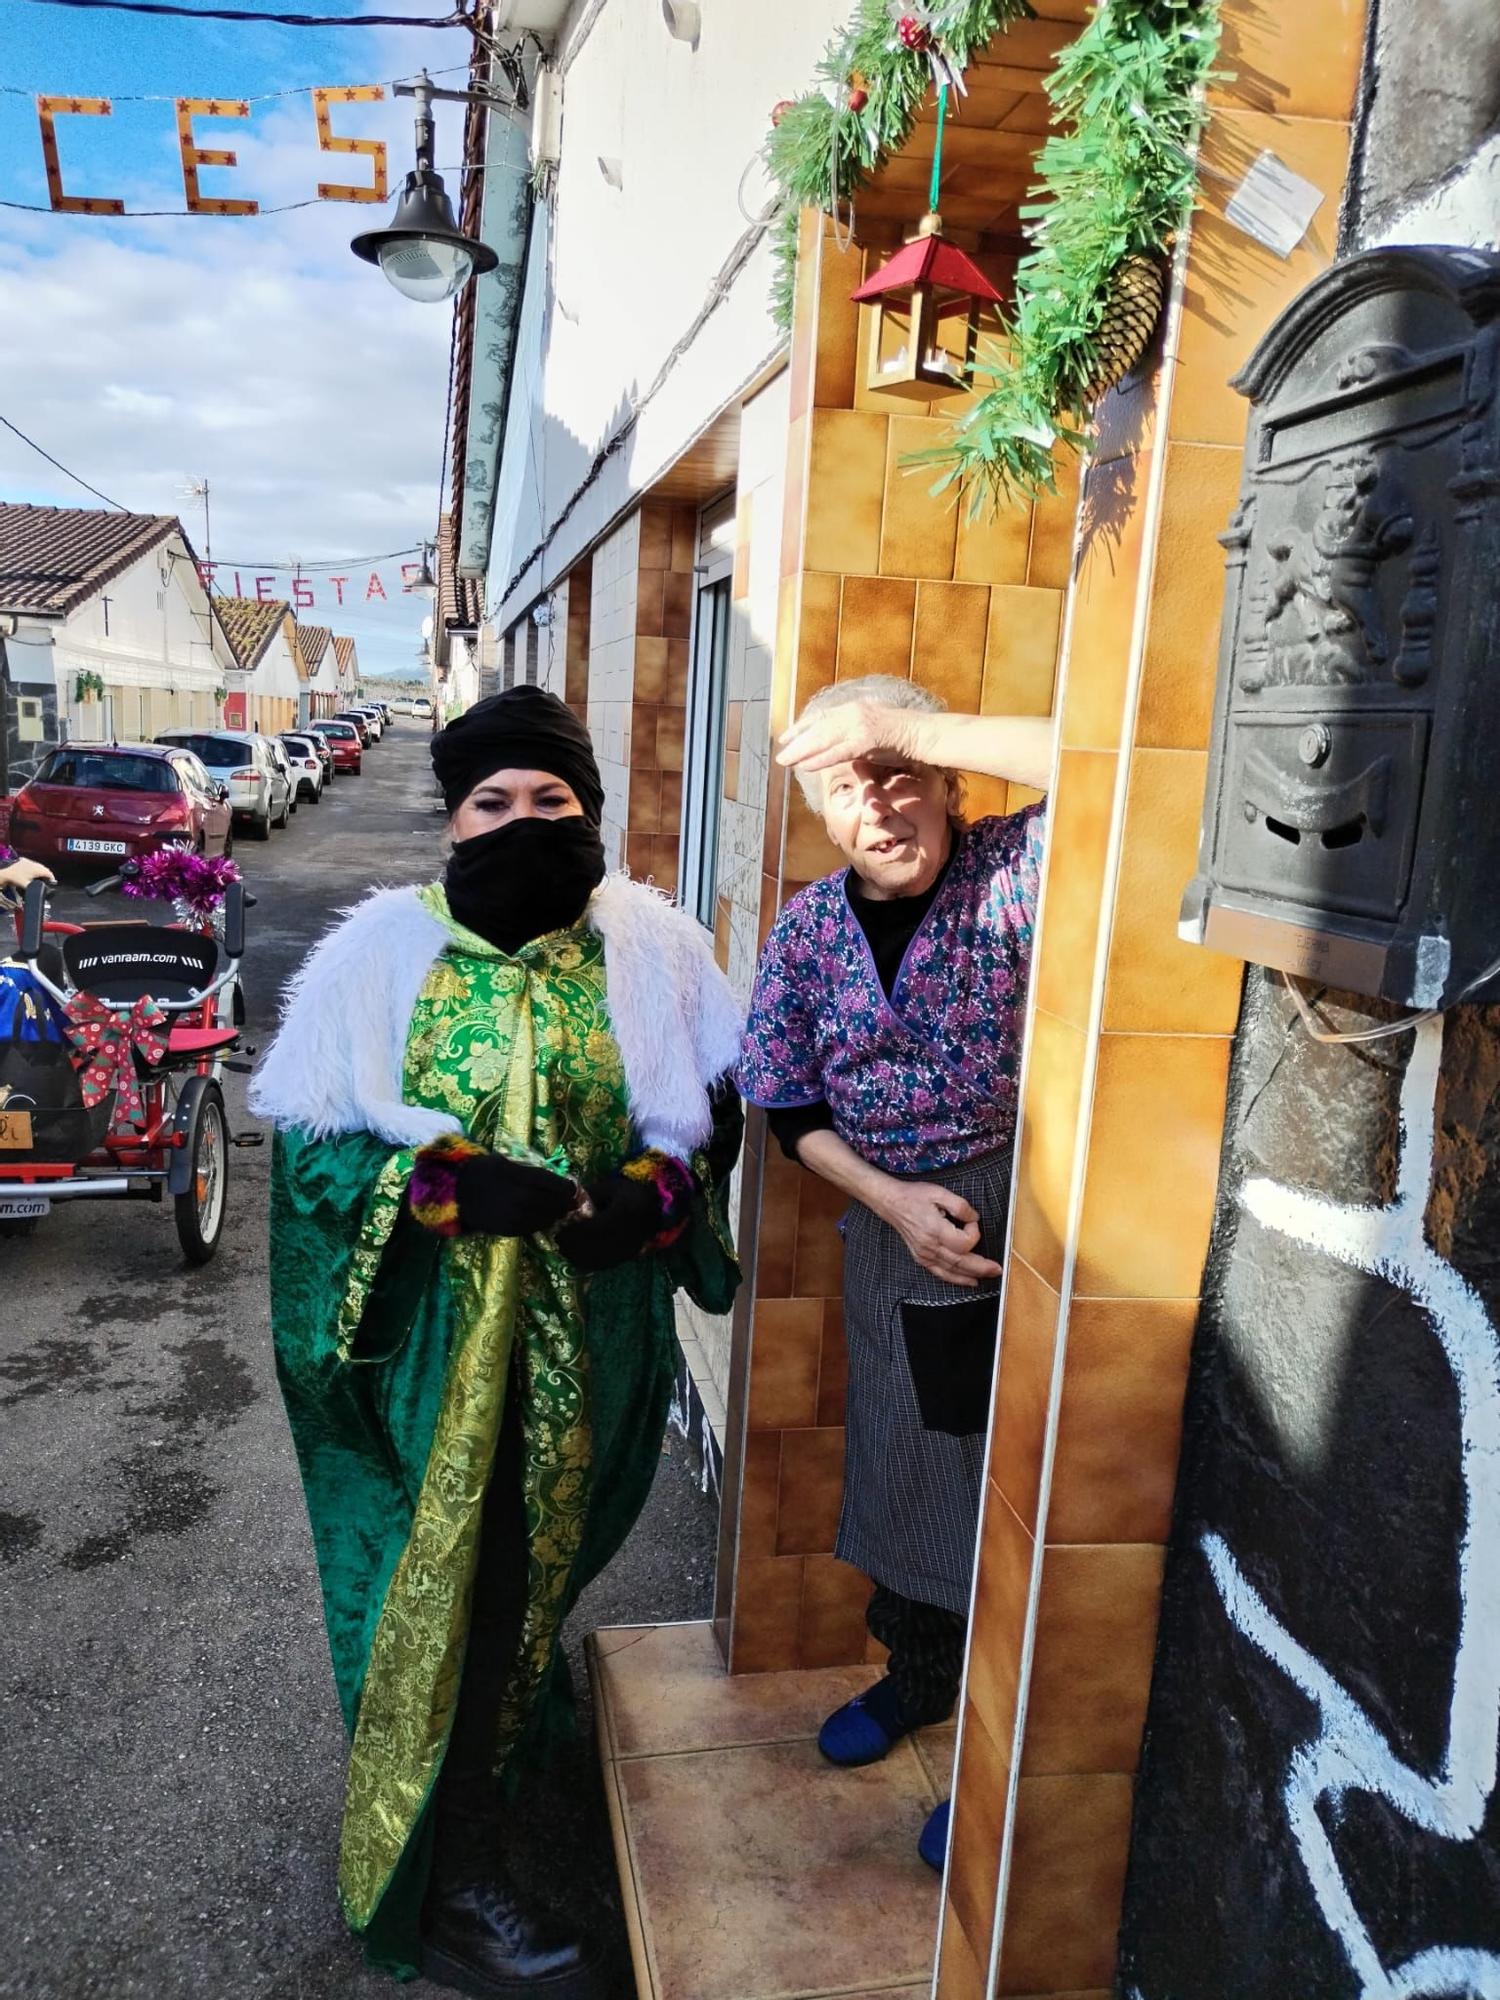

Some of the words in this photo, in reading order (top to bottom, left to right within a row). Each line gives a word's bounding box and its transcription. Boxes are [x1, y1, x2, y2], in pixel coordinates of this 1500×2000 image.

[76, 840, 101, 851] 4139
[103, 843, 123, 853] GKC
[101, 953, 177, 964] vanraam.com
